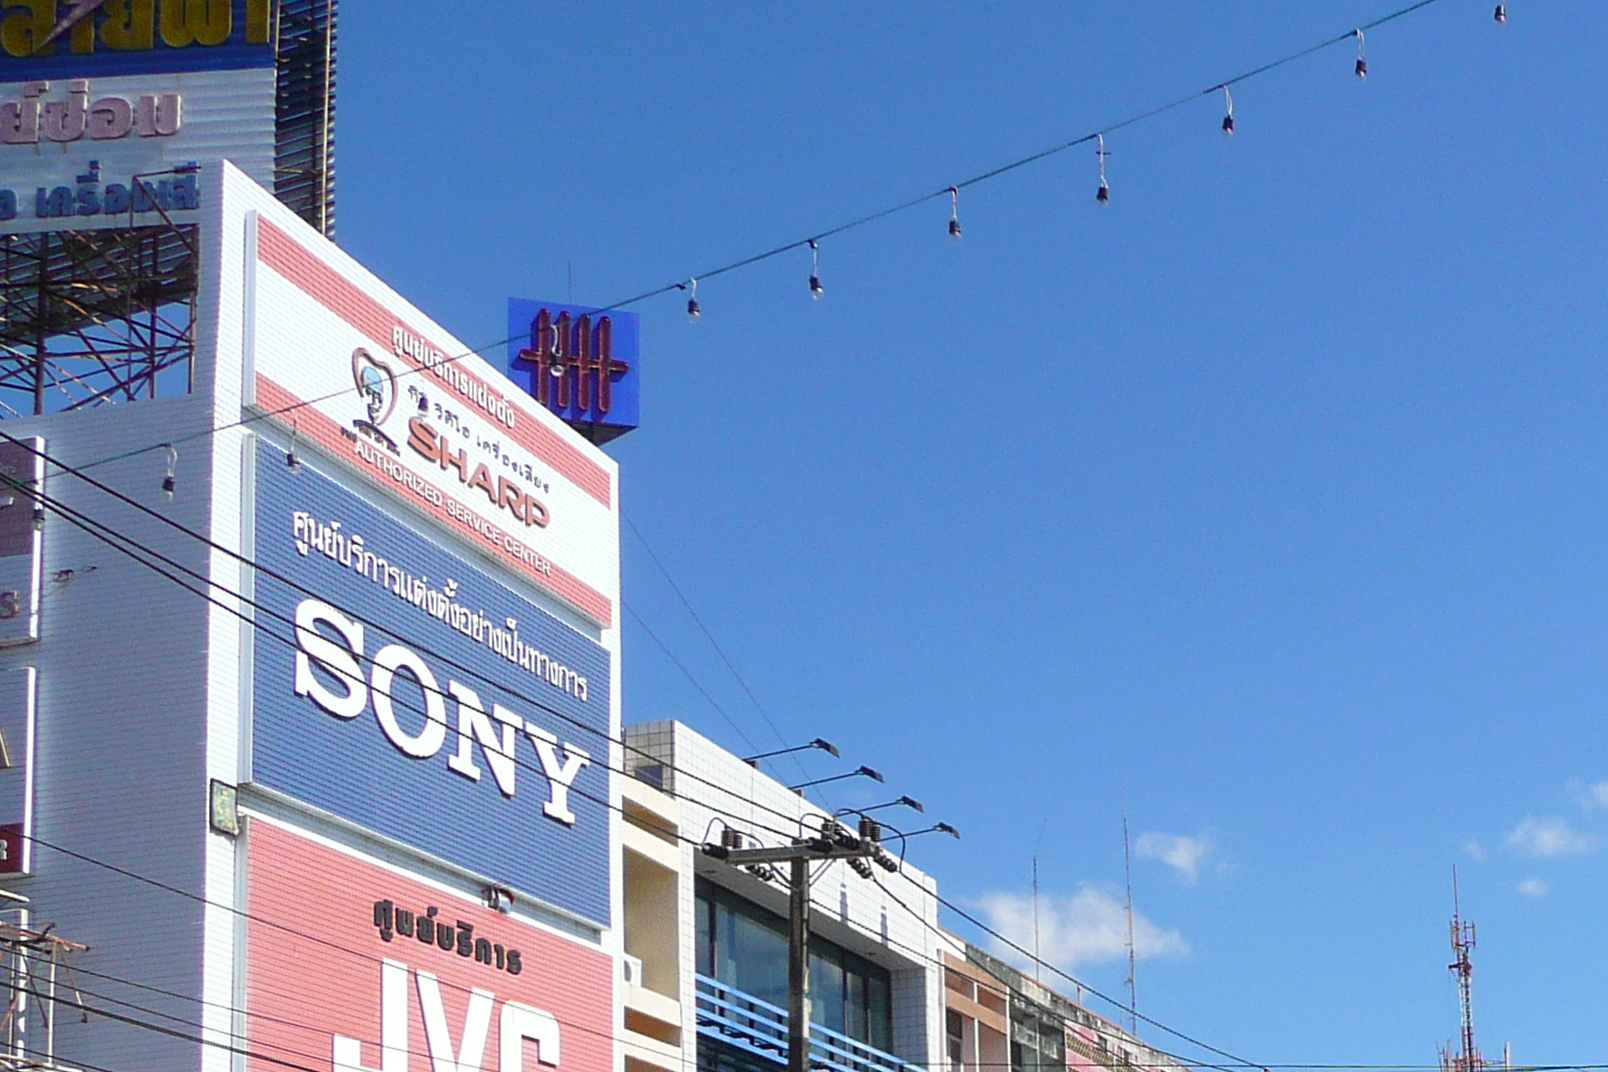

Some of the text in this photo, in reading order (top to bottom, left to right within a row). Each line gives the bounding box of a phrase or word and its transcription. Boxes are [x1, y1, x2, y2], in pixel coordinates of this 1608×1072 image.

[354, 440, 442, 508] AUTHORIZED
[445, 494, 501, 546] SERVICE
[504, 534, 551, 576] CENTER
[407, 416, 550, 529] SHARP
[292, 510, 588, 703] ศูนย์บริการแต่งตั้งอย่างเป็นทางการ
[294, 599, 590, 826] SONY
[372, 898, 523, 975] ศูนย์บริการ
